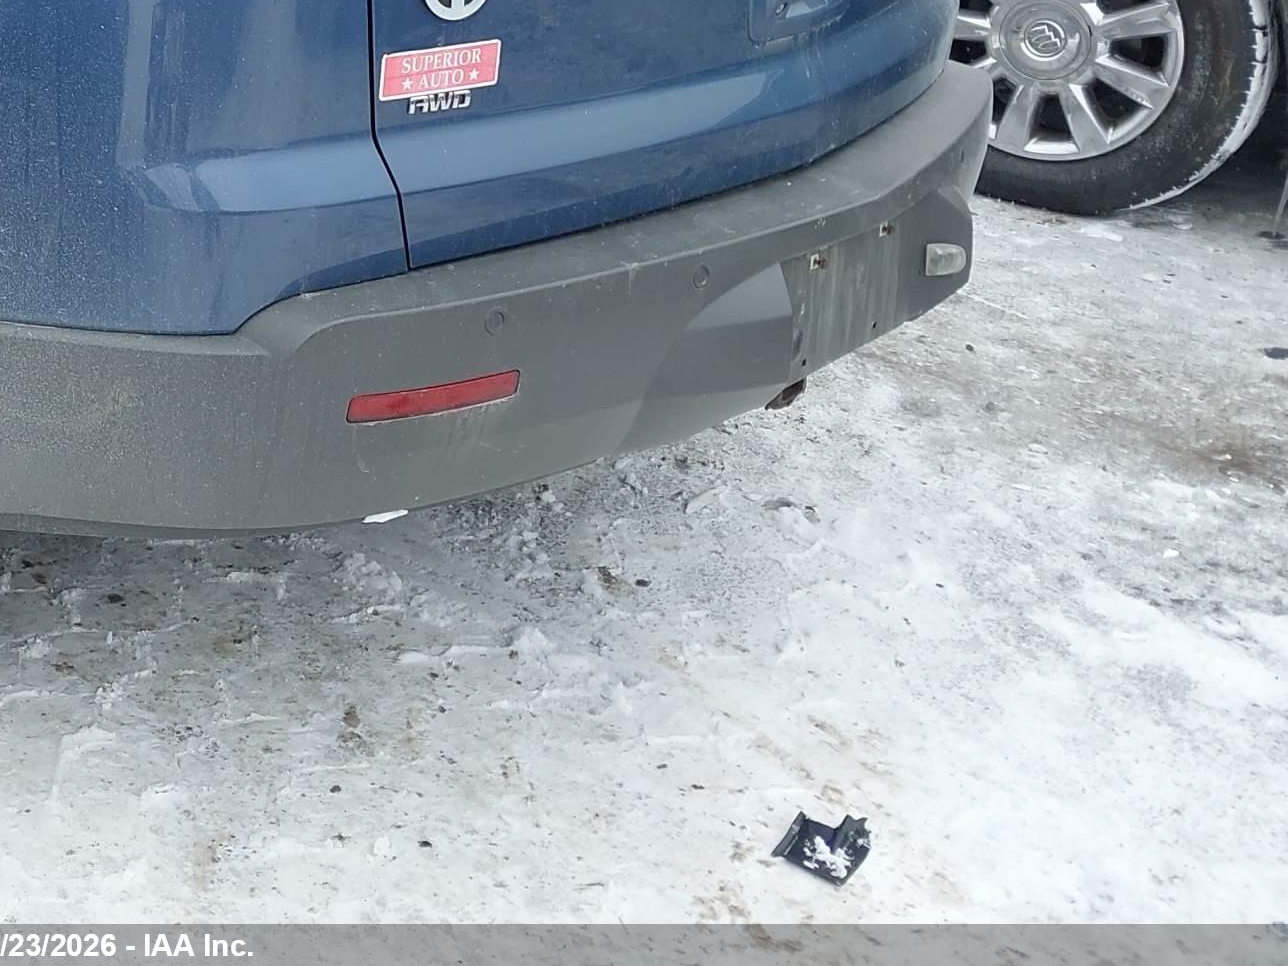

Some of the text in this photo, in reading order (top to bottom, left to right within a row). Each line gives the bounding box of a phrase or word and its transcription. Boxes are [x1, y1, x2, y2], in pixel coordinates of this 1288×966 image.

[400, 48, 482, 74] SUPERIOR
[418, 68, 464, 90] AUTO
[408, 90, 471, 115] AWD
